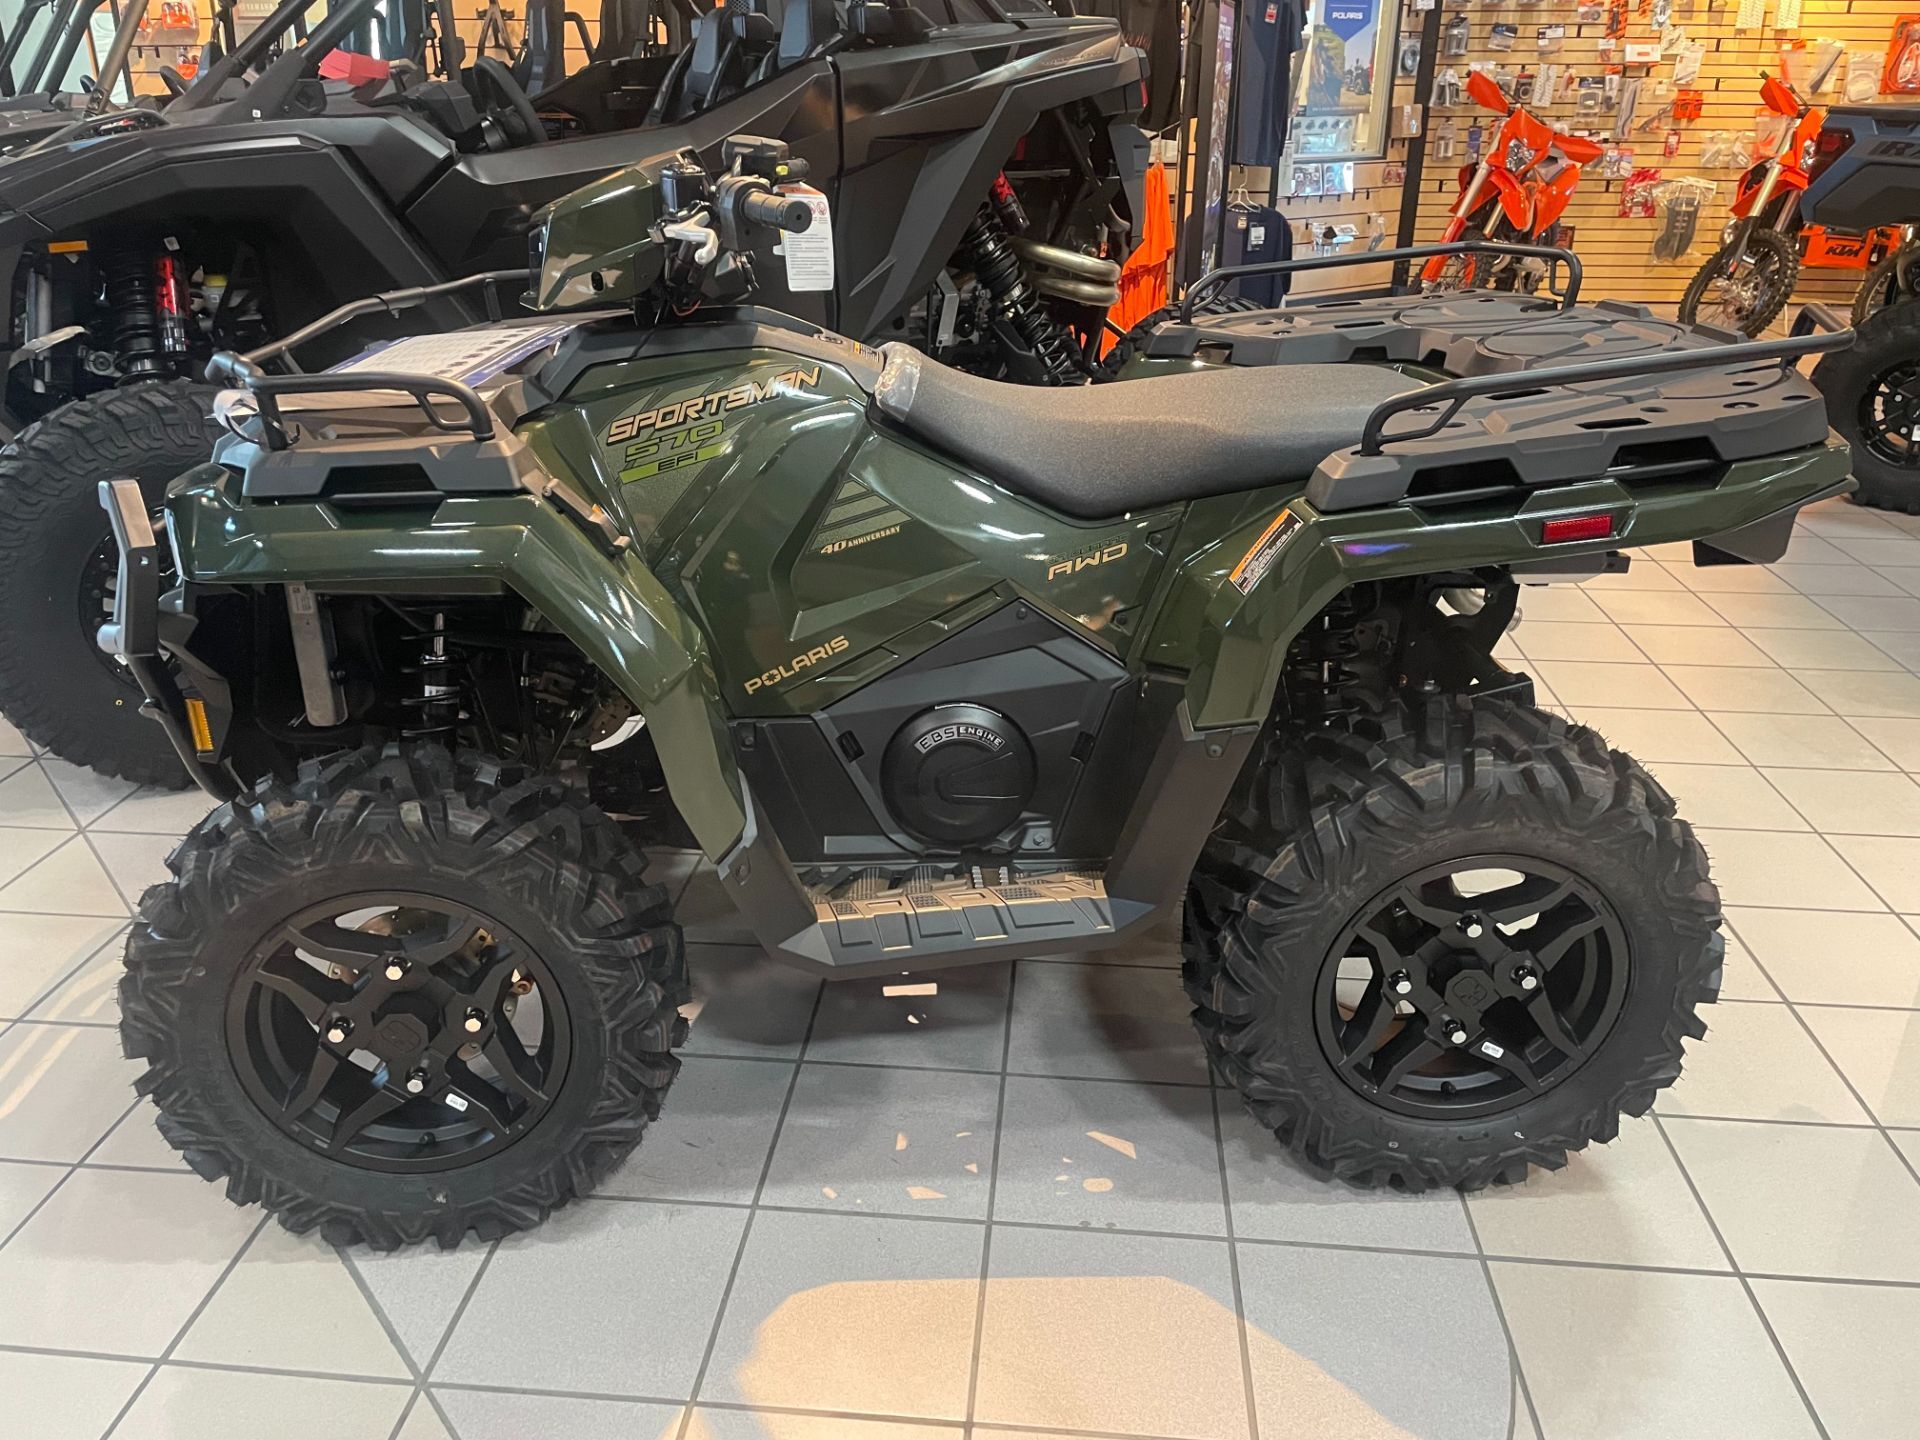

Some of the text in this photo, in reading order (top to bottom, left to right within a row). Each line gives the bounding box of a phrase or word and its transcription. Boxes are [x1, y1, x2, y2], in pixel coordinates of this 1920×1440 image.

[1332, 11, 1363, 20] POLARIS
[1825, 243, 1863, 258] KTM
[606, 366, 821, 447] SPORTSMAN
[625, 419, 724, 462] 570
[657, 452, 699, 473] EFI
[848, 525, 901, 548] ANNIVERSARY
[1048, 542, 1128, 581] AWD
[744, 635, 850, 695] POLARIS
[919, 726, 956, 750] EBS
[959, 725, 1002, 746] ENGINE
